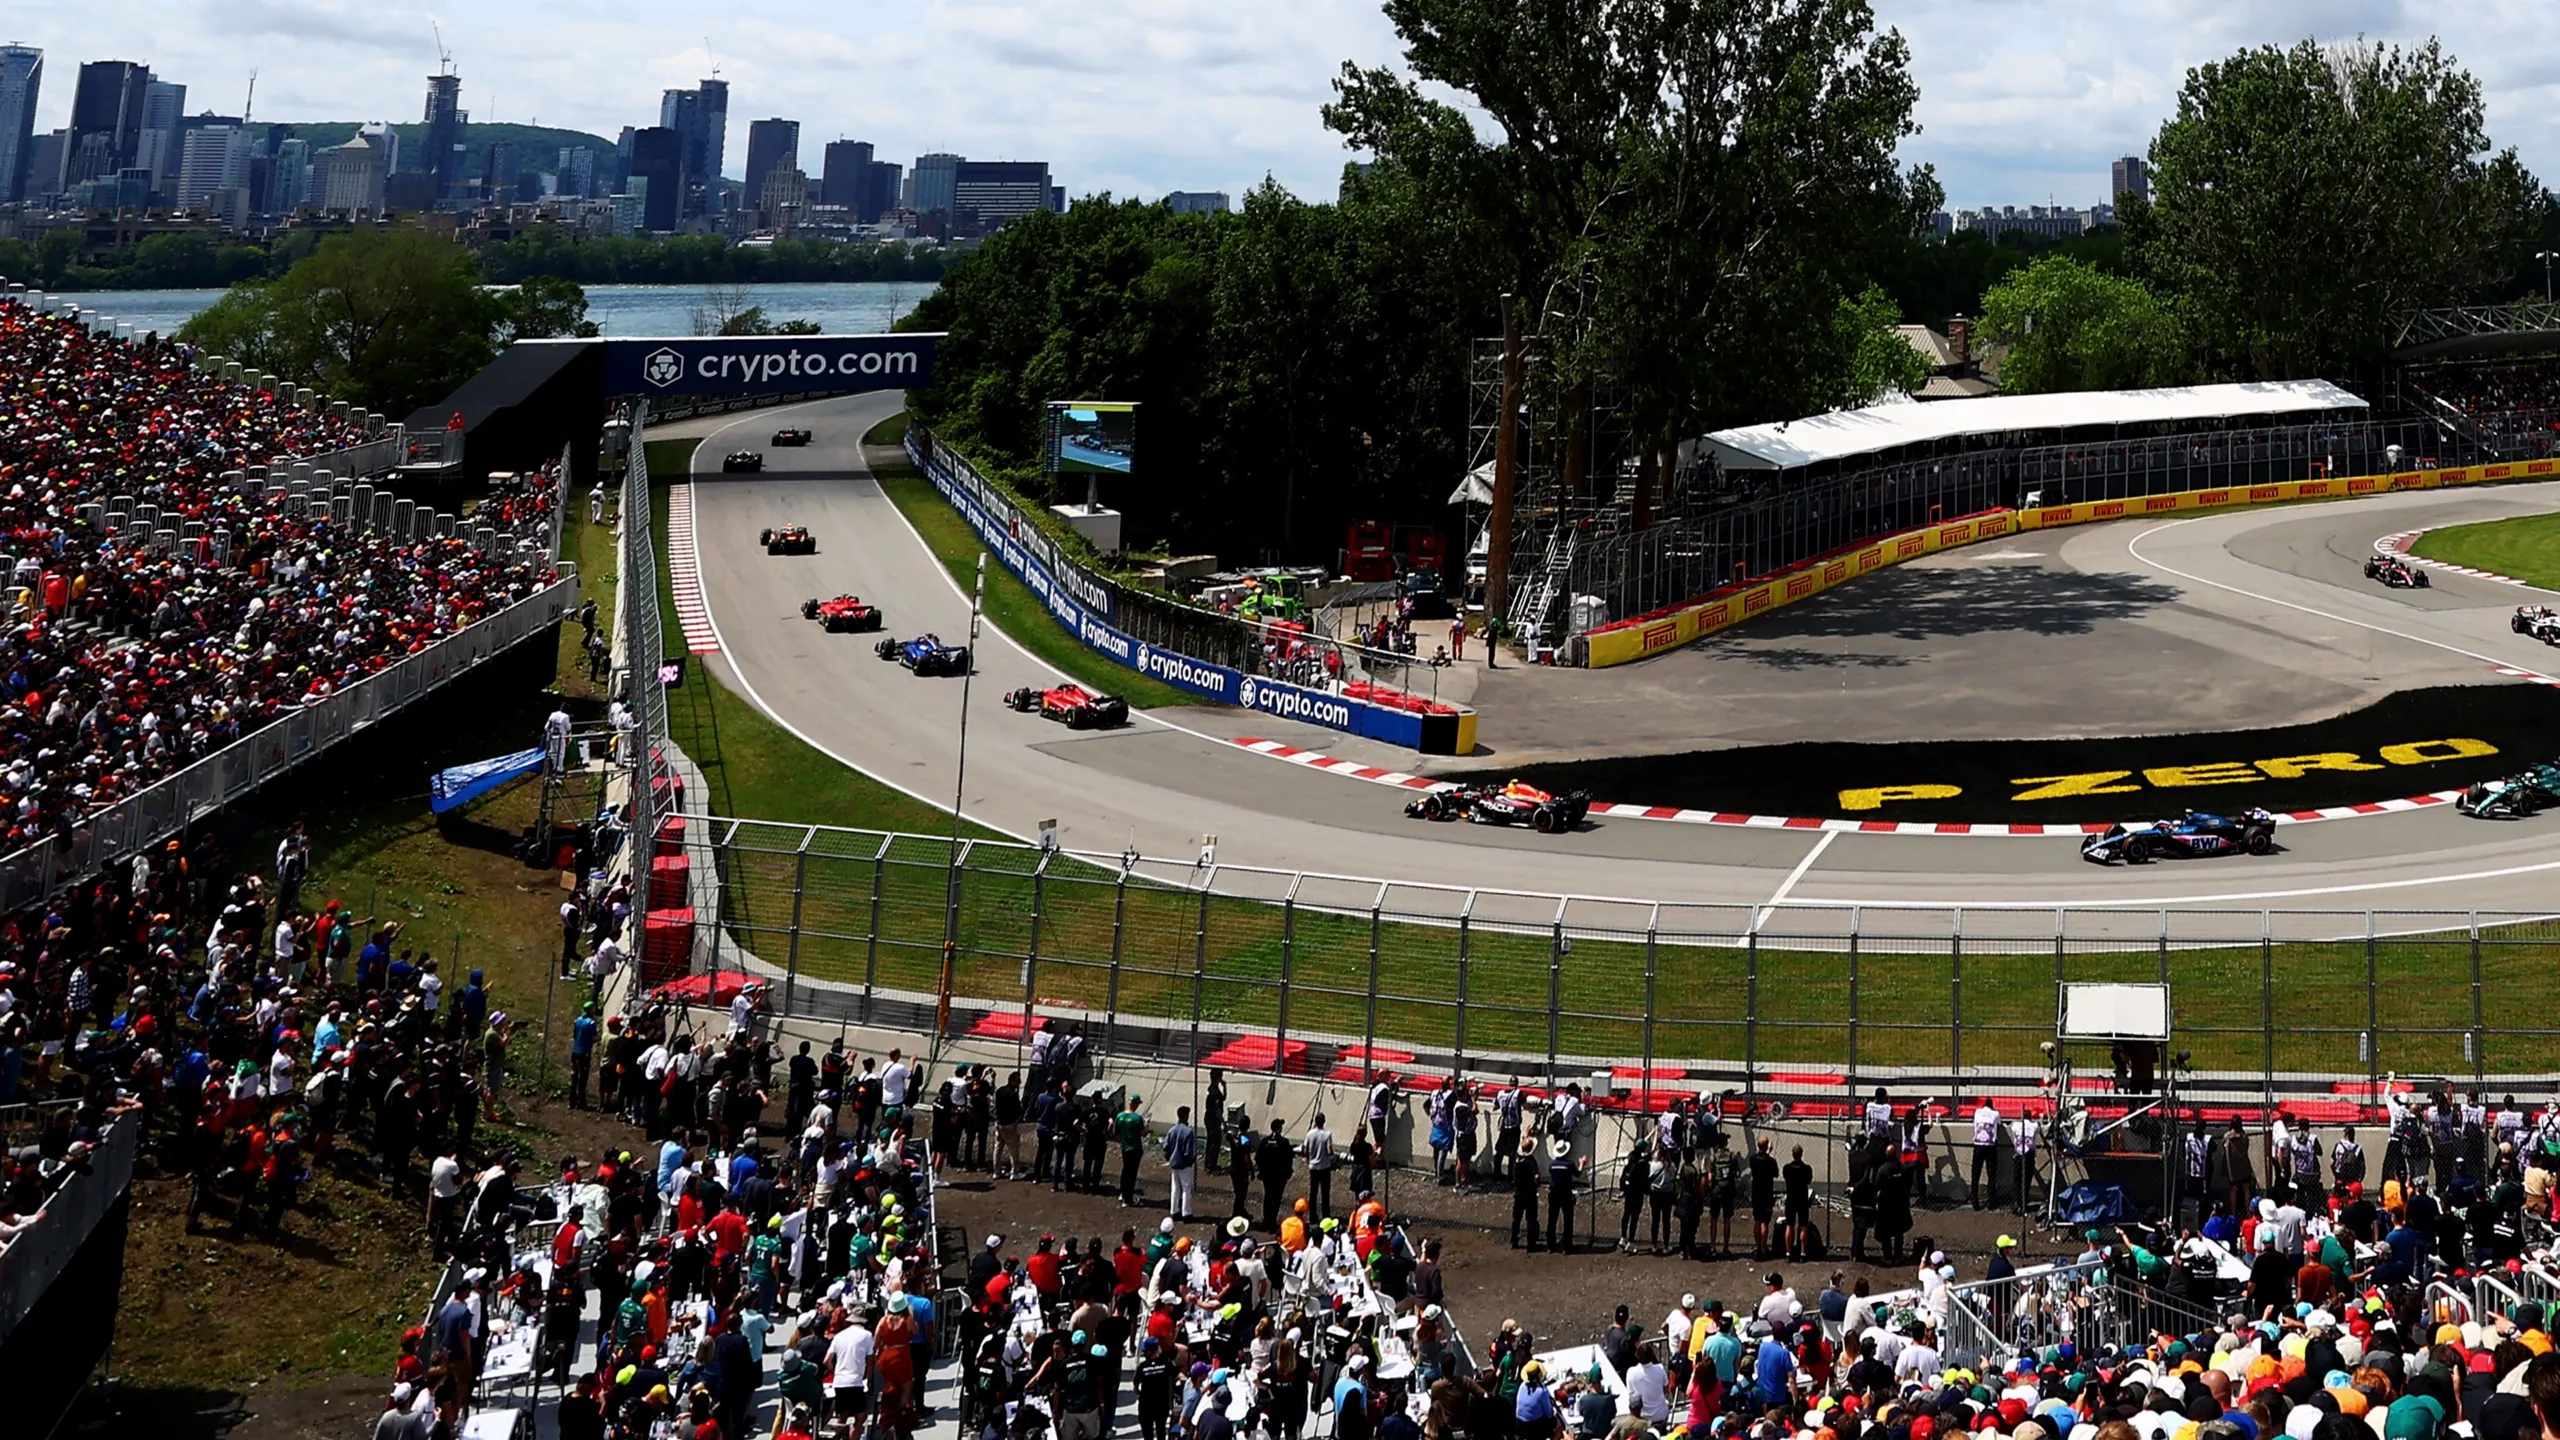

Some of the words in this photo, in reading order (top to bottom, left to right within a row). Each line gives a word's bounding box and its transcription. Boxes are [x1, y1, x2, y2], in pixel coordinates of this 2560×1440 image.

[698, 349, 917, 382] crypto.com
[1940, 524, 1970, 546] PIRELLI
[1978, 517, 2007, 537] PIRELLI
[1859, 548, 1882, 571] PIRELLI
[1898, 536, 1924, 558] PIRELLI
[1060, 559, 1107, 614] crypto.com
[1787, 574, 1812, 599] PIRELLI
[1824, 561, 1846, 584] PIRELLI
[1744, 587, 1770, 614] PIRELLI
[1698, 603, 1728, 632] PIRELLI
[1087, 622, 1128, 658] crypto.com
[1643, 622, 1677, 651] PIRELLI
[1151, 654, 1224, 692] crypto.com
[1259, 688, 1348, 726] crypto.com
[1838, 784, 1962, 811] P
[2012, 738, 2500, 801] ZERO
[2192, 837, 2220, 849] BWT
